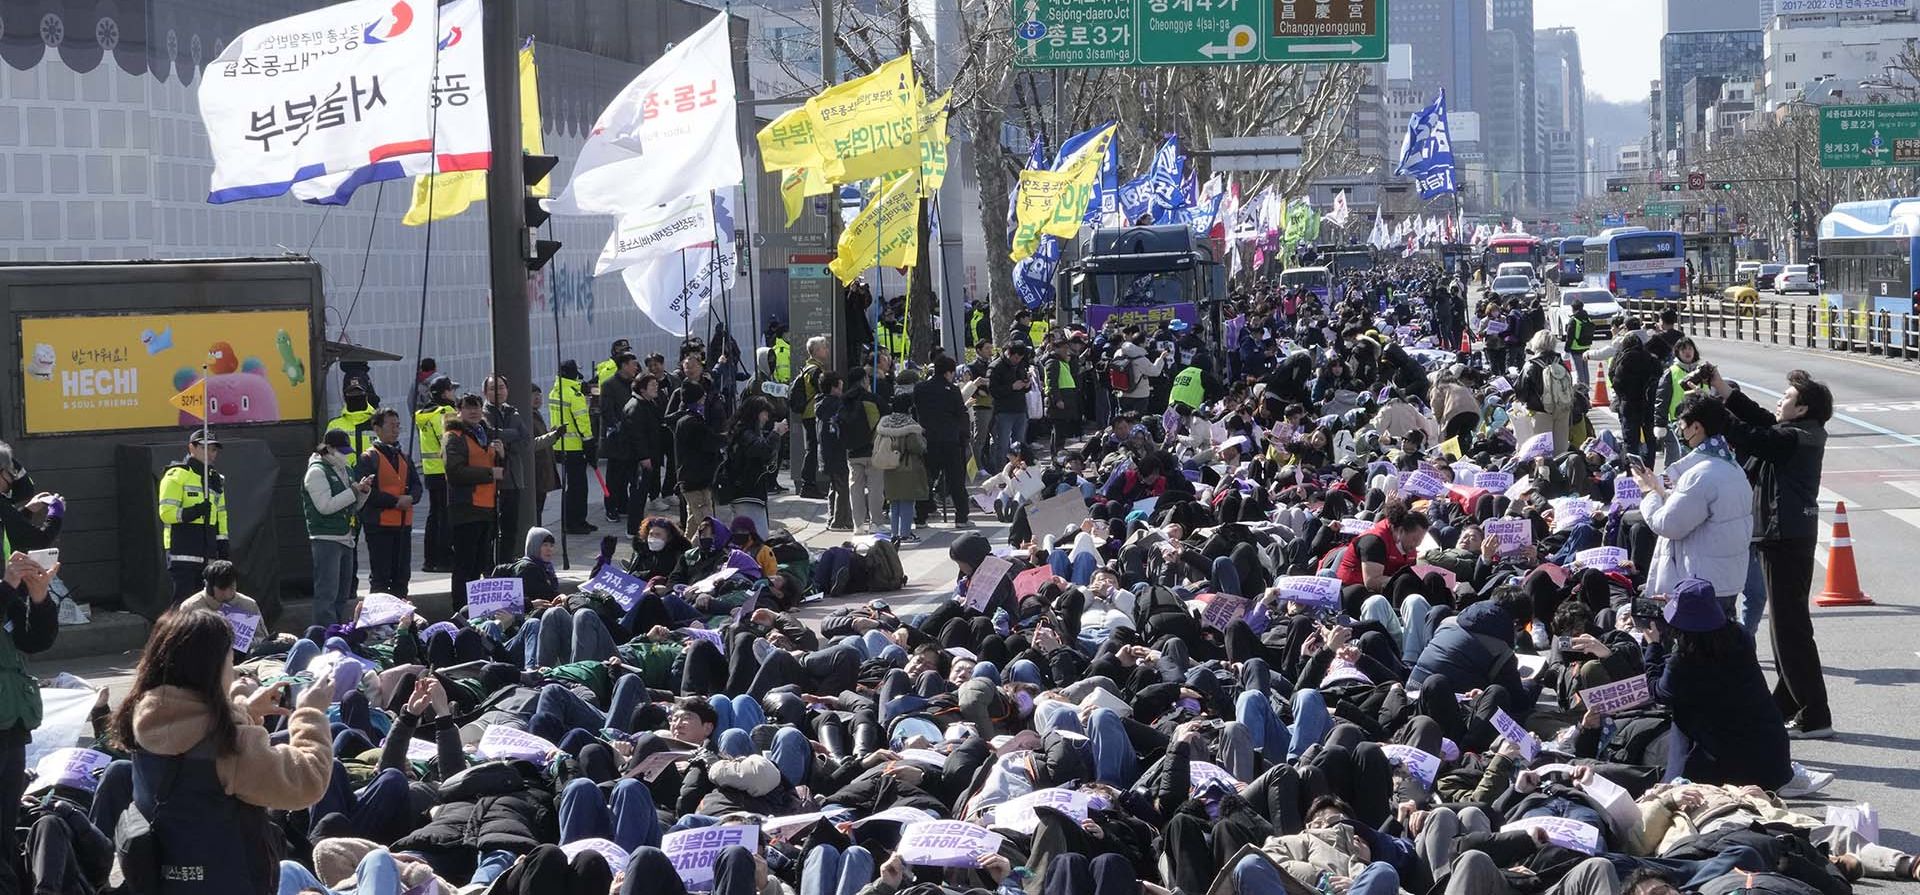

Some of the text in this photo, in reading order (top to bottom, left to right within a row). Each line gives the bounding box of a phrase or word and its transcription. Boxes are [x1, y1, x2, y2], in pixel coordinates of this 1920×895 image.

[1782, 0, 1827, 11] 2017-2022
[1150, 17, 1230, 34] Cheonggye 4(sa)-ga
[1279, 21, 1366, 36] Changgyeonggung
[1049, 24, 1131, 47] 종로3가
[1841, 120, 1875, 130] 종로2가
[1692, 178, 1702, 186] 50
[1656, 243, 1670, 252] 160
[71, 347, 129, 363] 반가워요!
[61, 367, 138, 397] HECHI
[71, 400, 95, 408] SOUL
[98, 398, 139, 408] FRIENDS
[471, 580, 514, 593] 성별임금
[602, 571, 622, 590] 가자,
[469, 591, 513, 605] 격차해소
[1588, 679, 1648, 704] 성별임금
